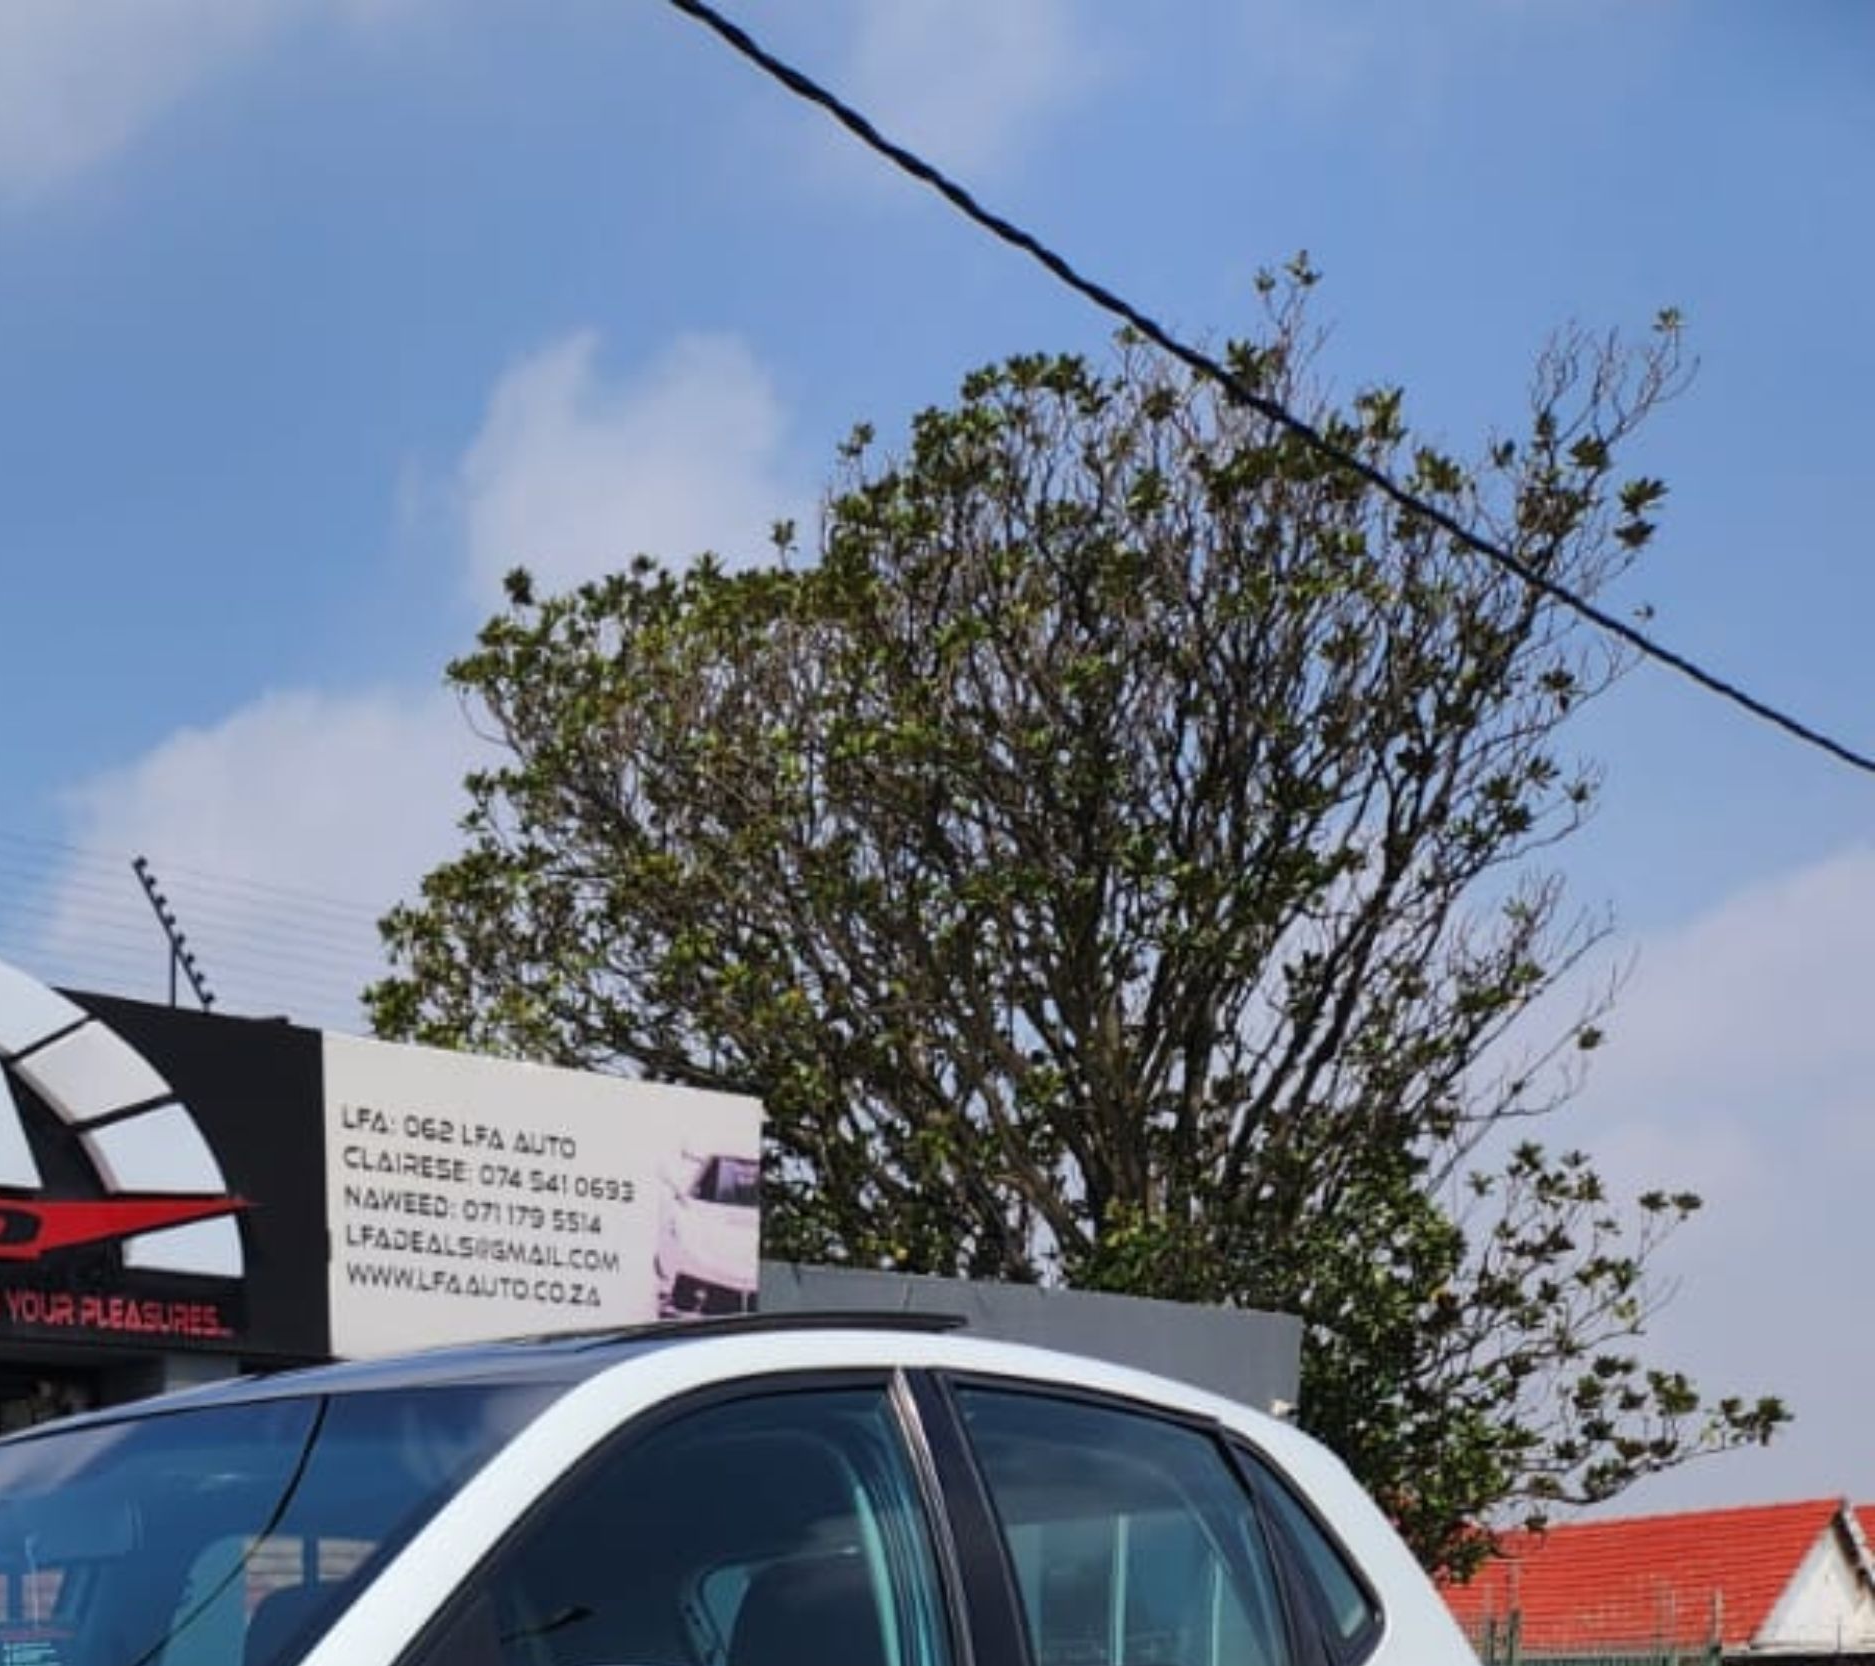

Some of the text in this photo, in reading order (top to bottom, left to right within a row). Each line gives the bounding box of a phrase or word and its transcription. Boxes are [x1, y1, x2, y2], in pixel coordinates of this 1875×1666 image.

[341, 1103, 577, 1160] LFA: 062 LFA AUTO
[479, 1163, 523, 1189] 074
[529, 1169, 568, 1195] 541
[462, 1198, 502, 1224] 071
[345, 1260, 602, 1308] WWW.LFAAUTO.CO.ZA
[6, 1287, 75, 1325] YOUR
